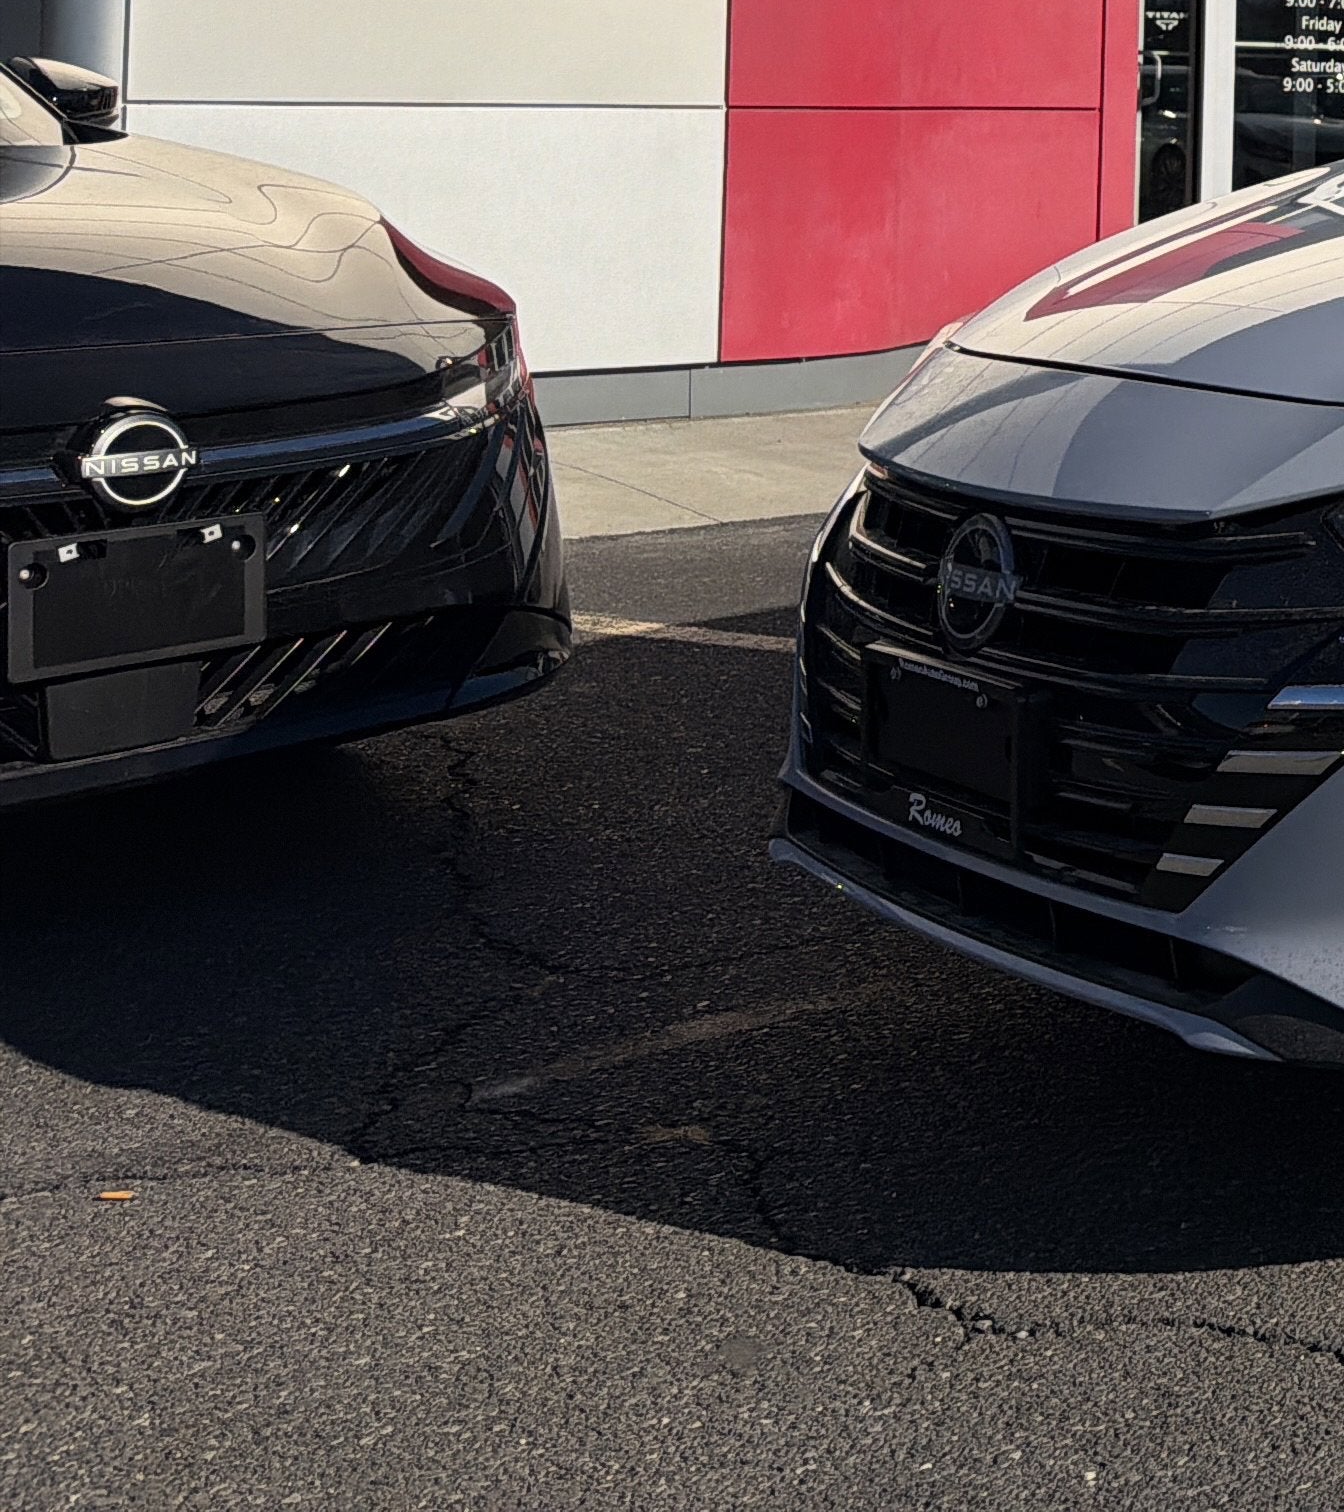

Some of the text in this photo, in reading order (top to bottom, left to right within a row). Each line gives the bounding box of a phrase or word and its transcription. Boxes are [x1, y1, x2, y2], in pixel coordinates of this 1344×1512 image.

[1302, 15, 1342, 34] Friday
[1284, 34, 1315, 51] 9:00
[1283, 77, 1314, 92] 9:00
[85, 450, 197, 477] NISSAN
[908, 792, 962, 837] Romeo
